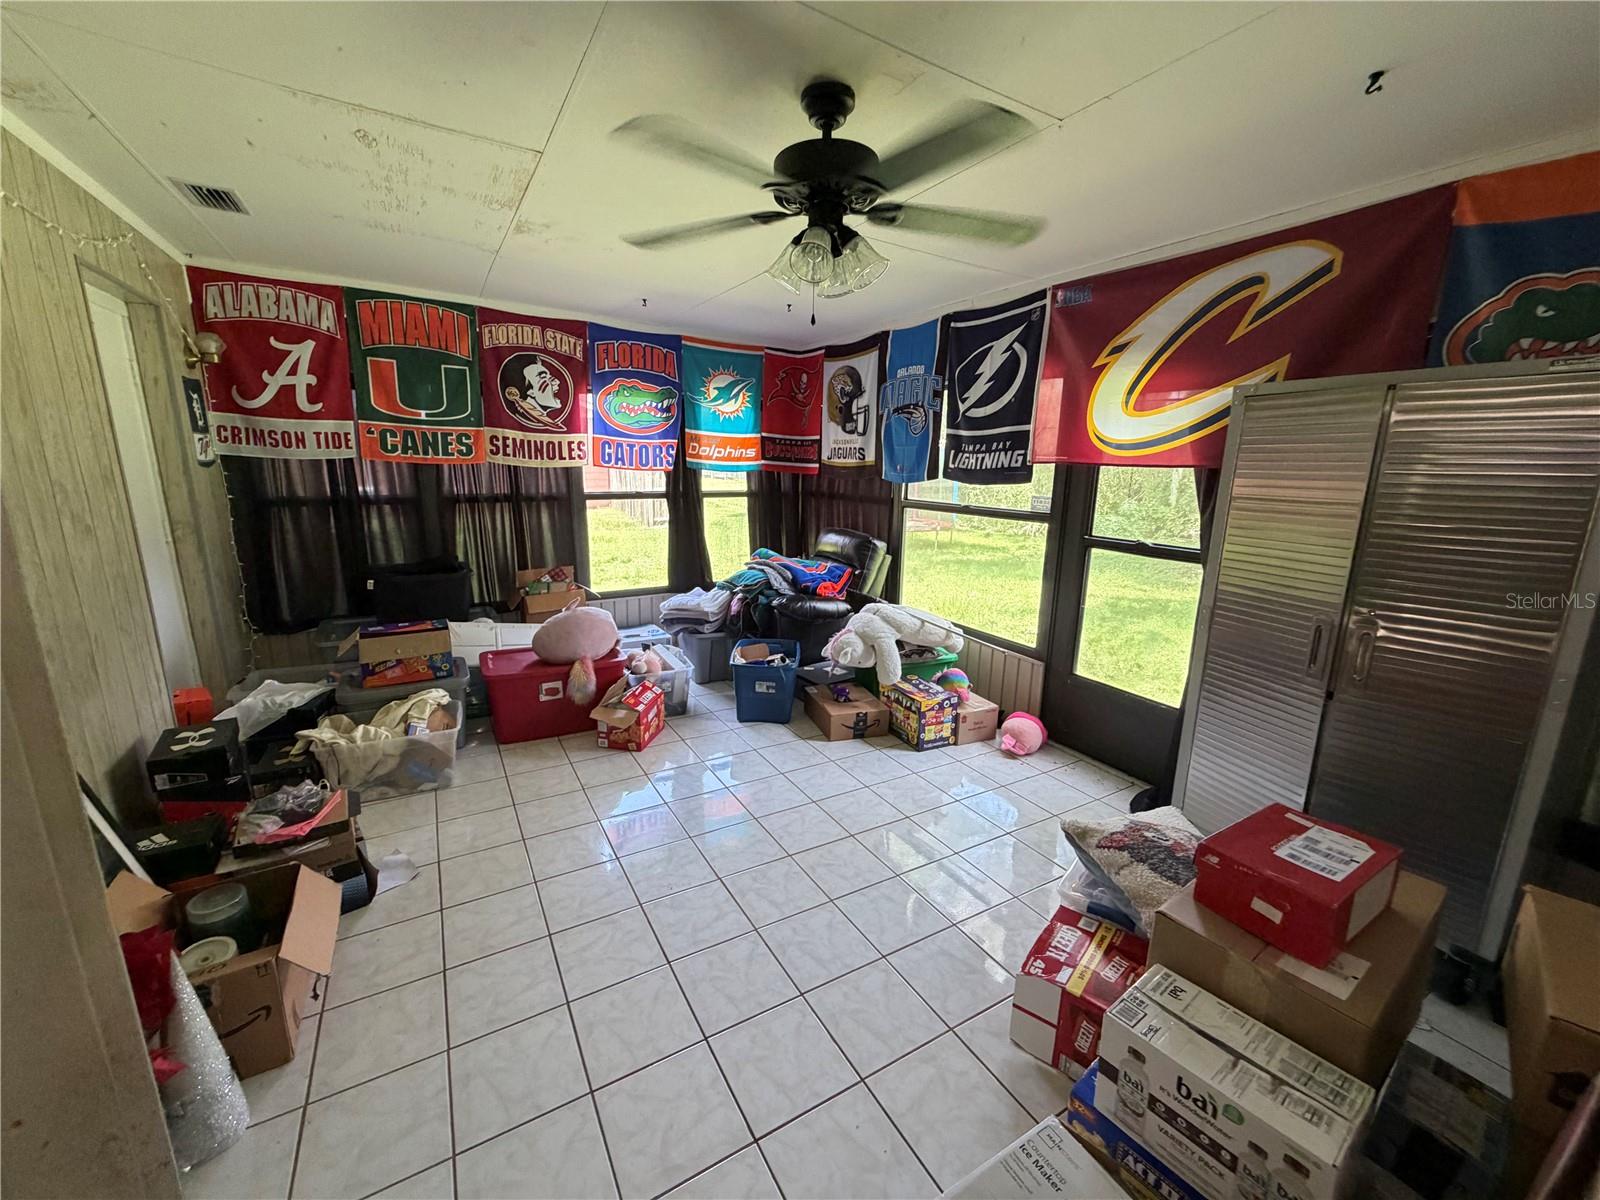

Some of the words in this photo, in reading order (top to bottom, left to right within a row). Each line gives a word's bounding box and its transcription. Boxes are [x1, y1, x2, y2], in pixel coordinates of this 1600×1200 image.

[203, 281, 342, 338] ALABAMA
[355, 298, 472, 361] MIAMI
[481, 323, 544, 350] FLORIDA
[544, 329, 584, 362] STATE
[231, 335, 324, 413] A
[595, 341, 678, 382] FLORIDA
[897, 365, 926, 378] ORLANDO
[366, 356, 472, 421] U
[216, 424, 311, 449] CRIMSON
[313, 430, 353, 450] TIDE
[488, 434, 588, 462] SEMINOLES
[688, 442, 756, 459] Dolphins
[827, 447, 866, 460] JAGUARS
[961, 443, 986, 451] TAMPA
[992, 441, 1011, 450] BAY
[600, 440, 675, 470] GATORS
[948, 450, 1026, 470] LIGHTNING
[1029, 958, 1046, 976] 45
[1123, 1070, 1144, 1093] bai
[1177, 1075, 1218, 1120] bai
[1018, 1143, 1034, 1161] Ice
[1032, 1157, 1064, 1194] Maker
[1025, 1138, 1067, 1186] Countertop
[1158, 1124, 1196, 1156] VARIETY
[1198, 1155, 1225, 1180] PACK
